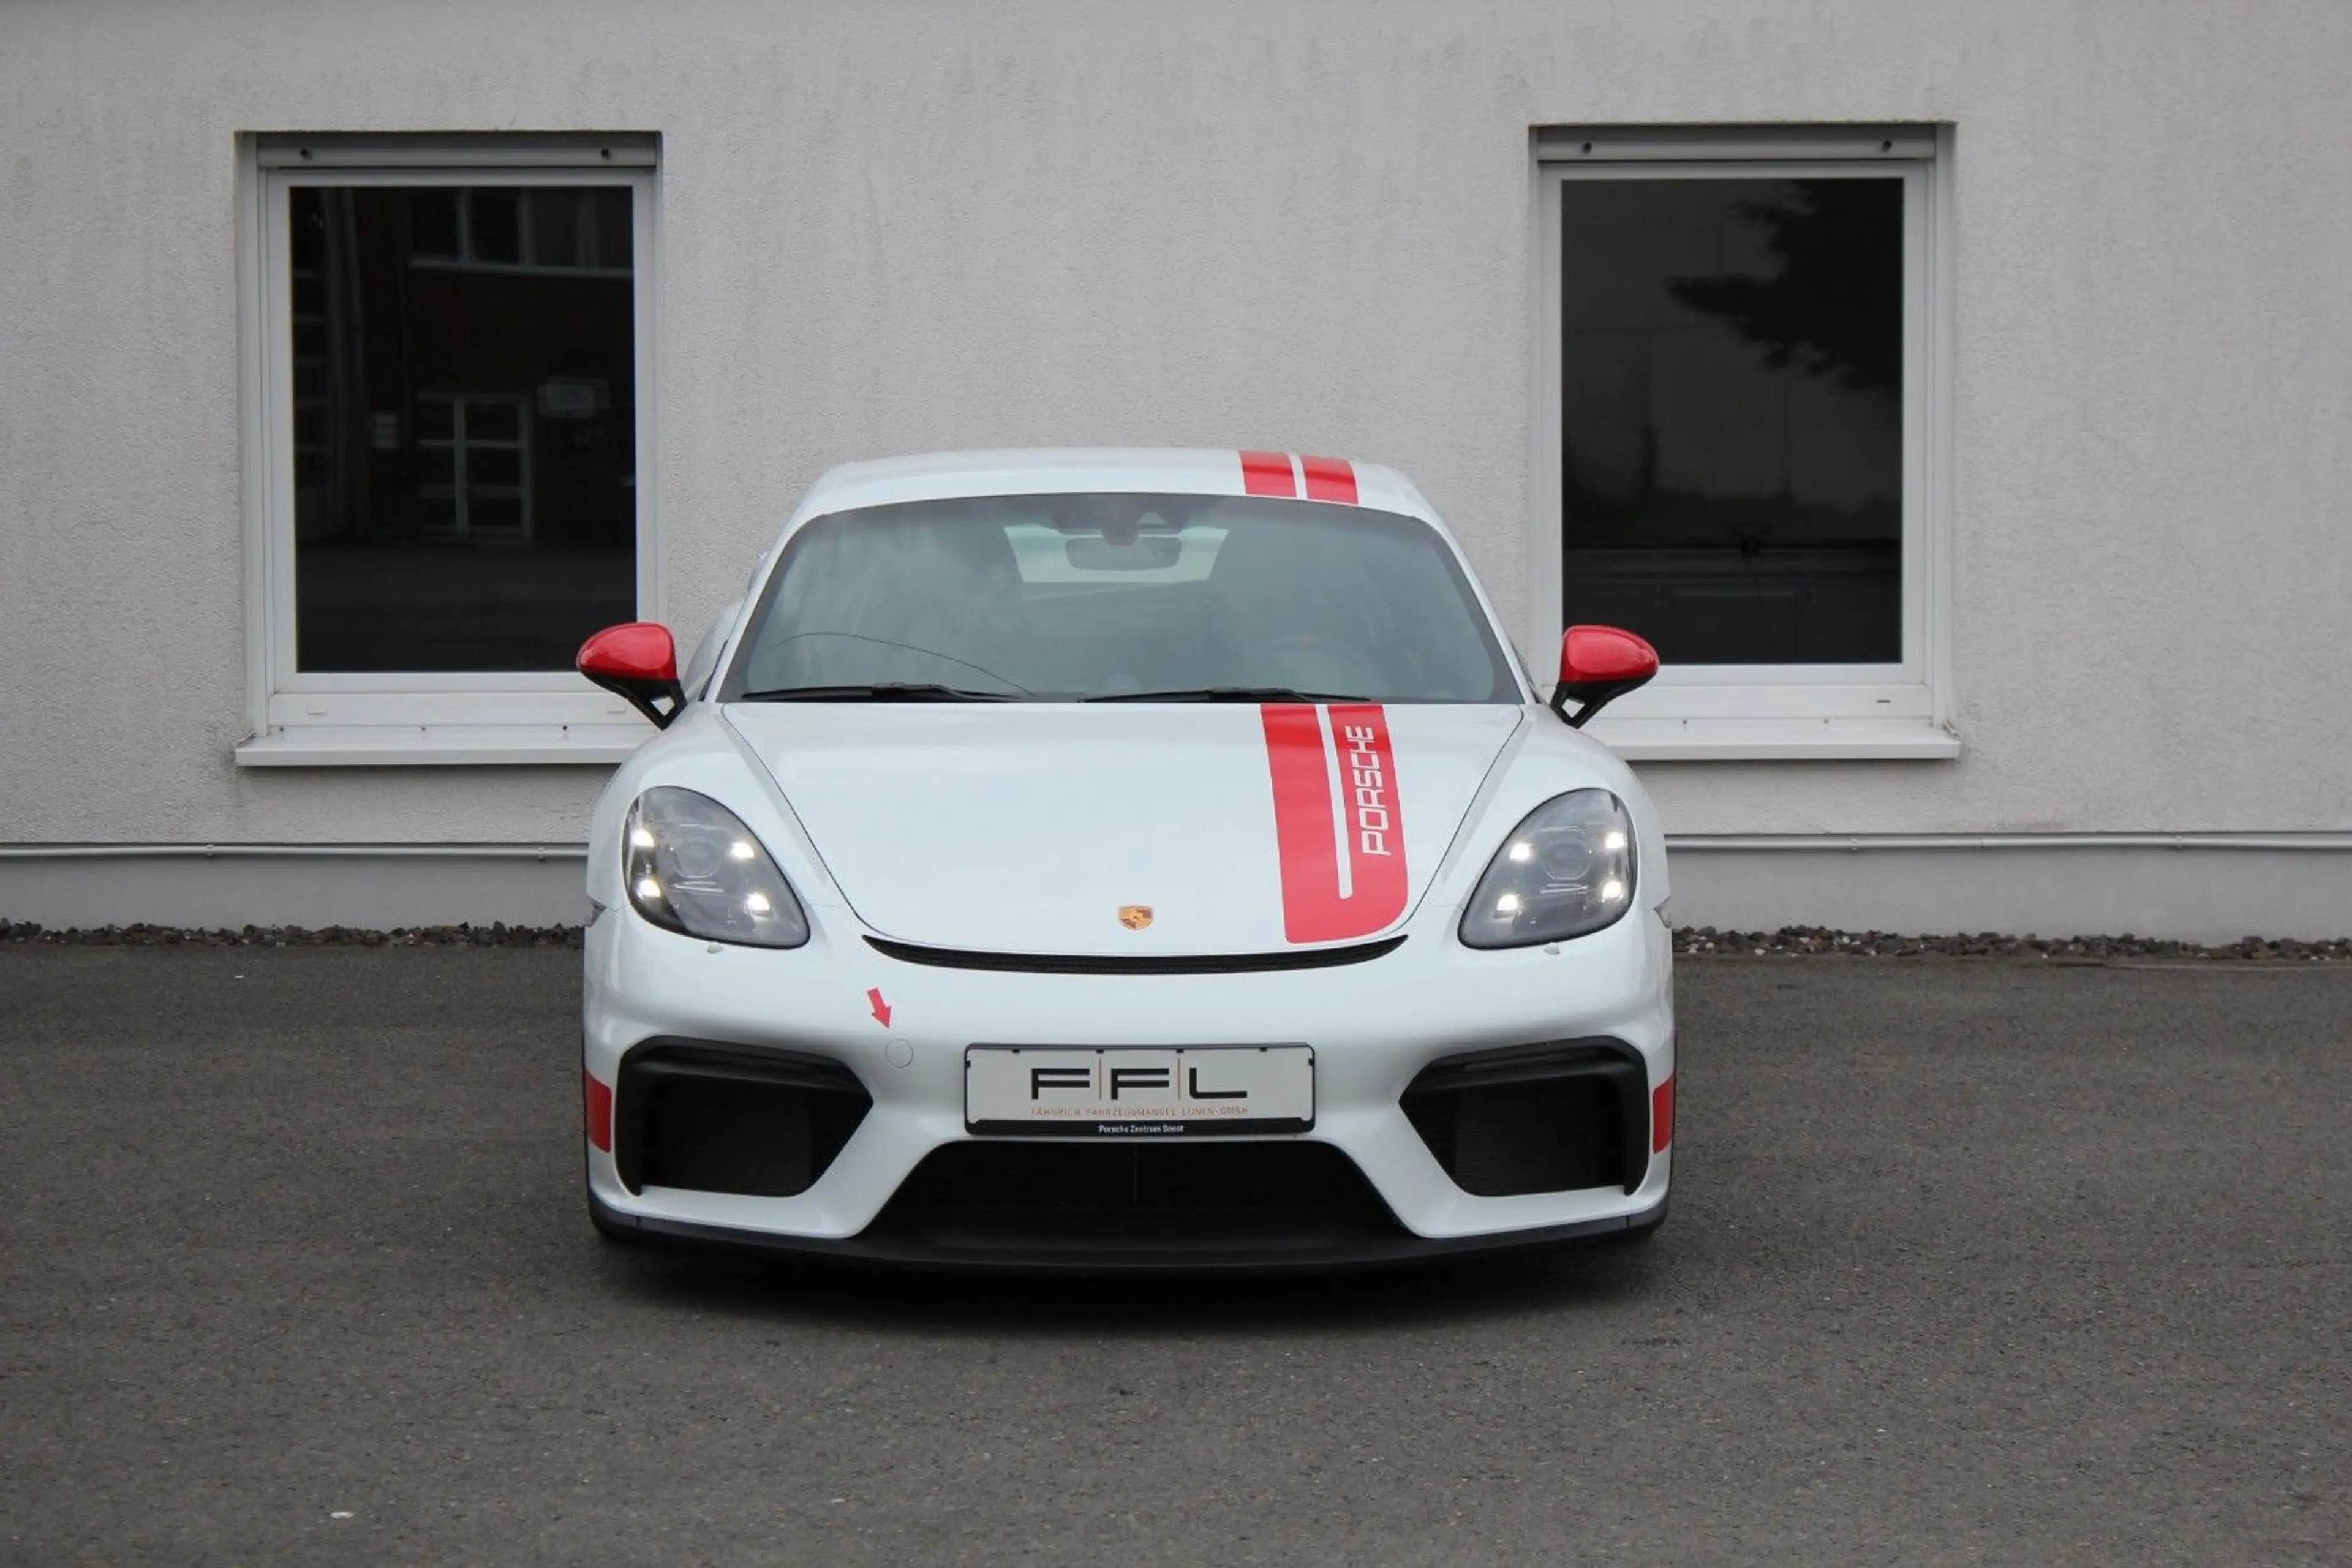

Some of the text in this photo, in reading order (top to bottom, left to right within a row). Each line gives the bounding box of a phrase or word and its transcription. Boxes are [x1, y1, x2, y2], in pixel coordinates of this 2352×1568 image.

[1345, 726, 1392, 856] PORSCHE
[1099, 1125, 1128, 1133] Porsche
[1130, 1124, 1161, 1133] Zentrum
